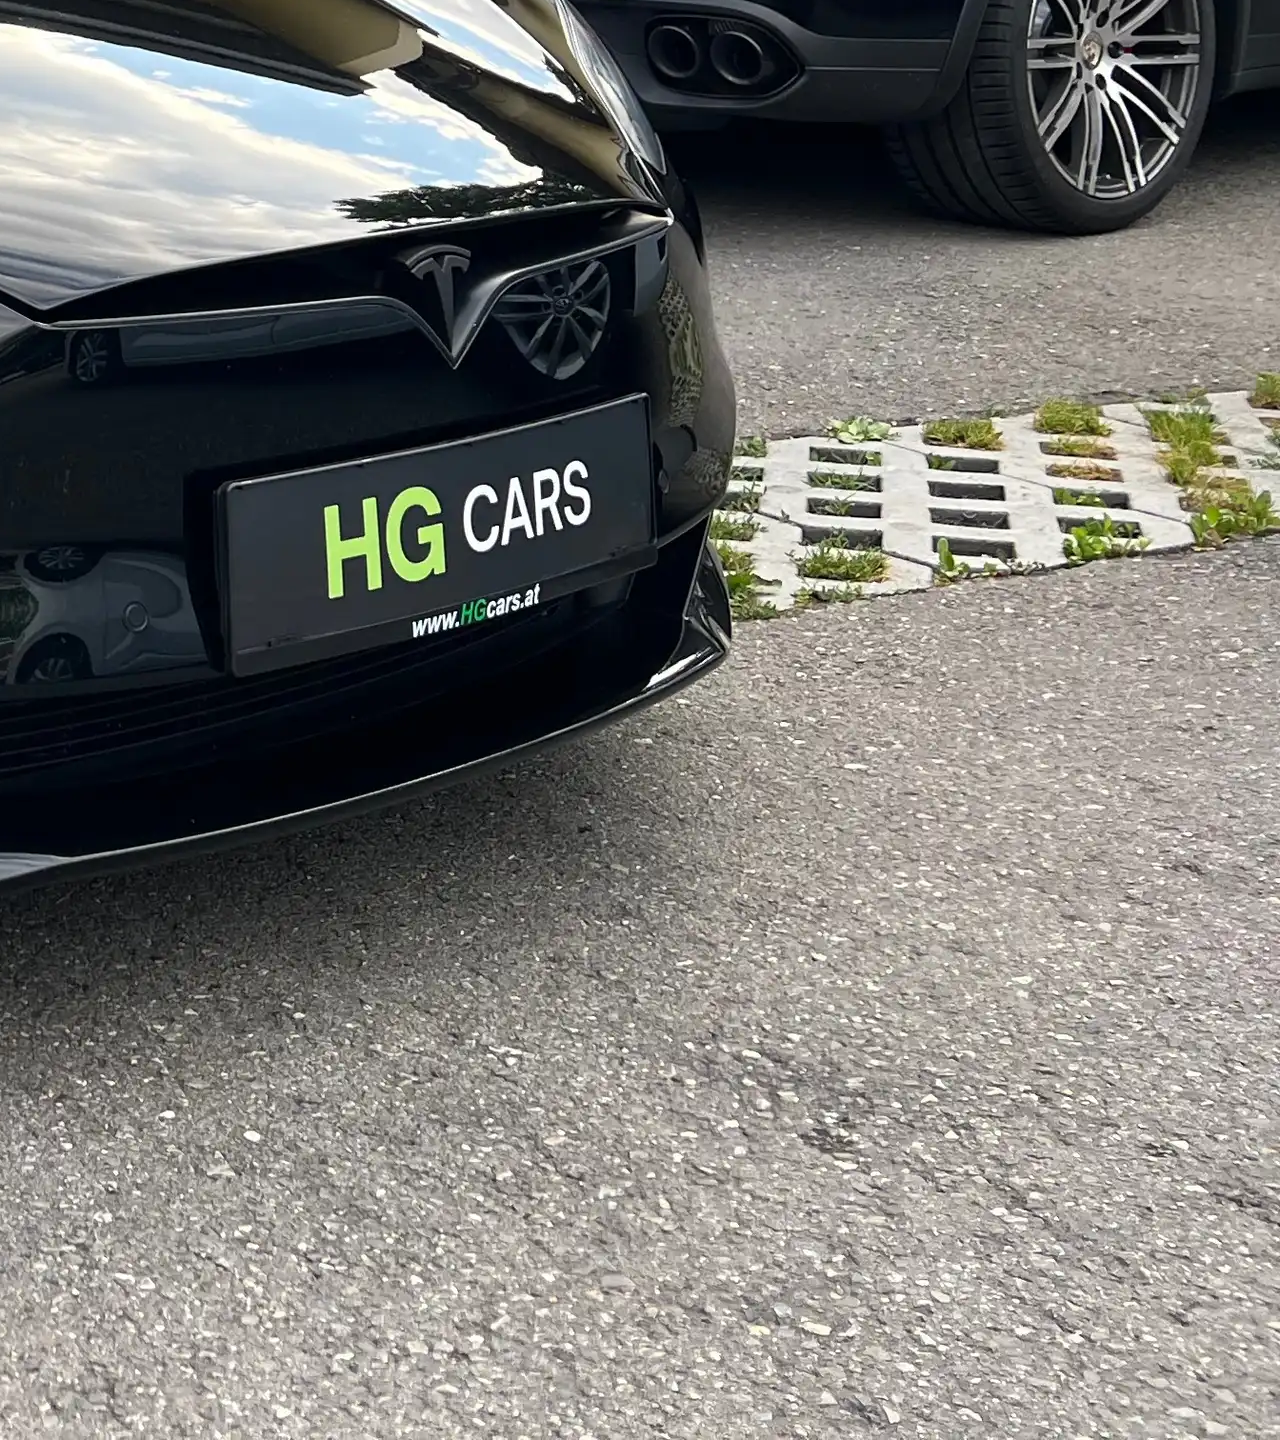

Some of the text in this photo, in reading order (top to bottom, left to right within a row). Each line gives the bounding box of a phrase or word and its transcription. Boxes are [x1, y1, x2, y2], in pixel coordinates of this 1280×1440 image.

[323, 460, 592, 600] HG CARS
[411, 582, 541, 639] www.HGcars.at
